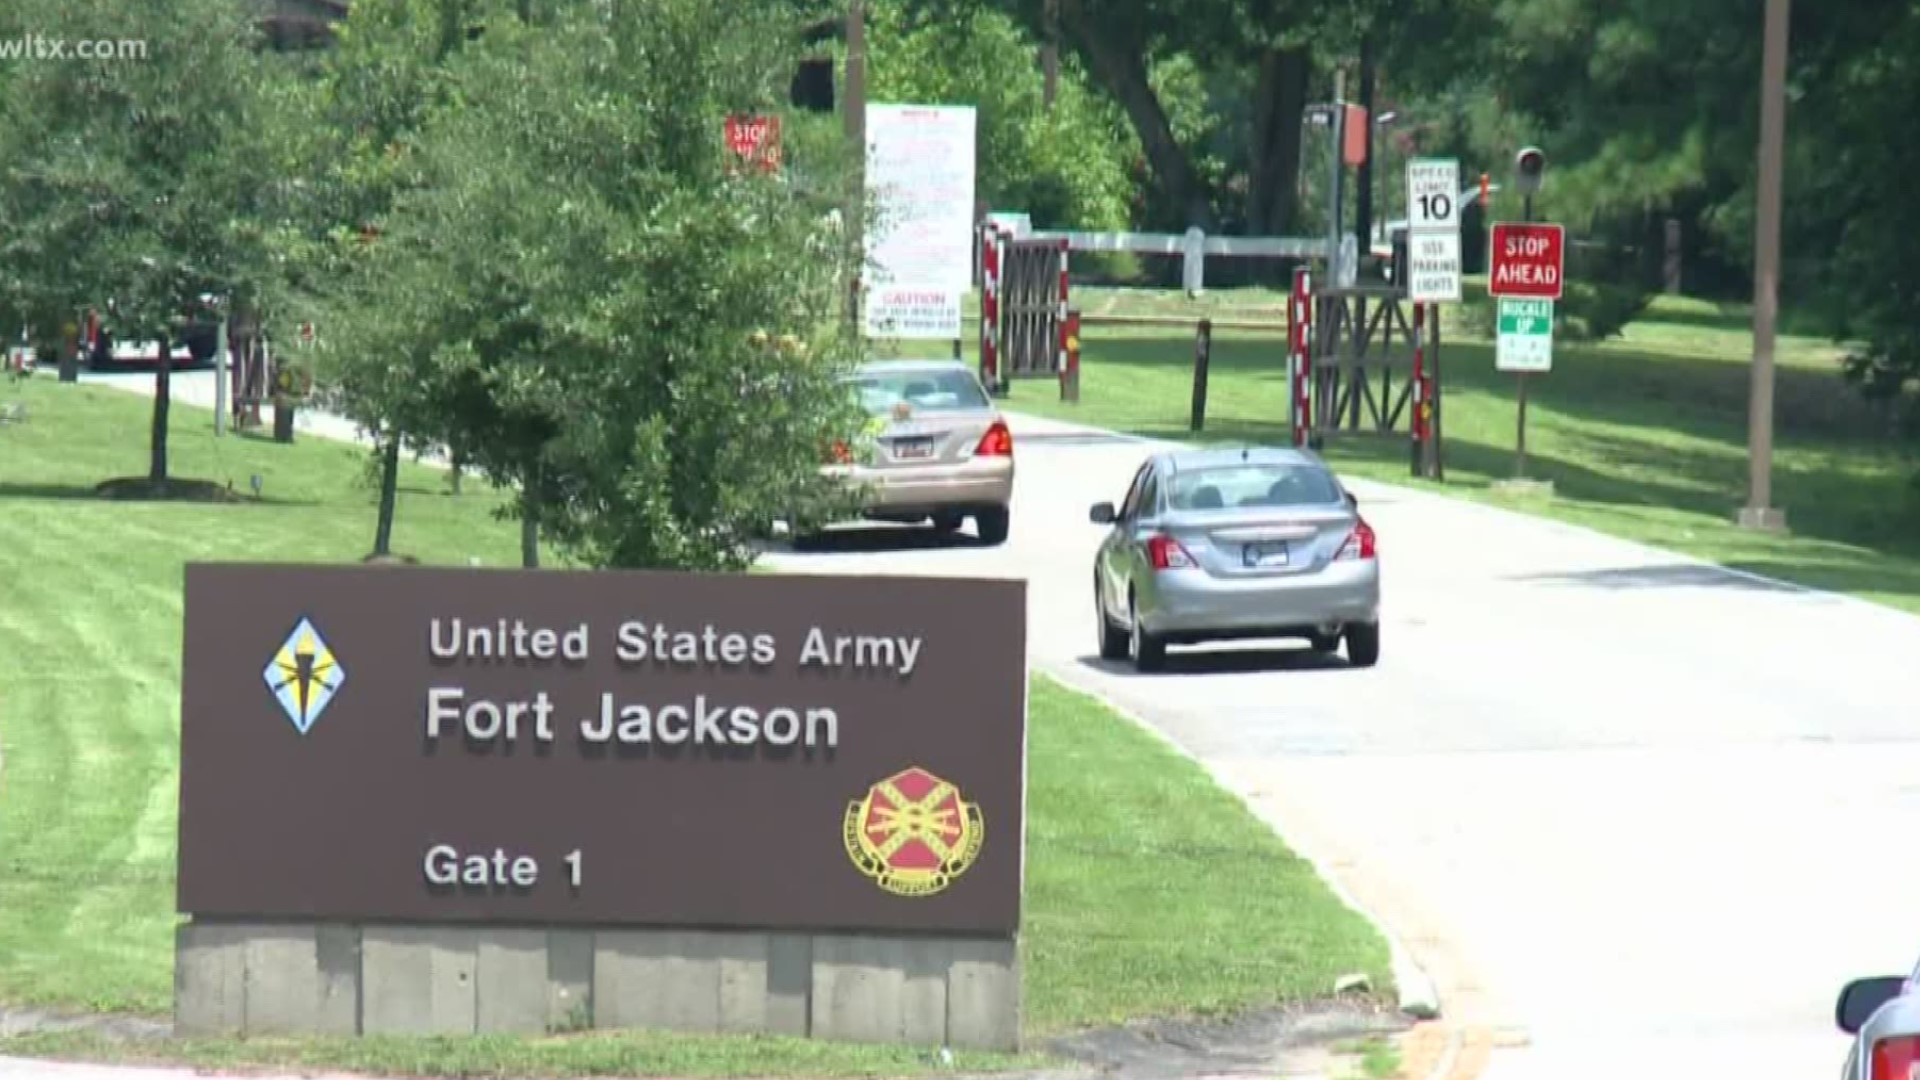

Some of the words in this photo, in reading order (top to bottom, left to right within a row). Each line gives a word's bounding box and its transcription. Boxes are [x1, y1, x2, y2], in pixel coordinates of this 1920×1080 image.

[1412, 167, 1454, 178] SPEED
[1415, 181, 1449, 191] LIMIT
[1418, 193, 1451, 220] 10
[1505, 236, 1549, 256] STOP
[1413, 258, 1457, 272] PARKING
[1496, 264, 1557, 285] AHEAD
[1416, 277, 1453, 291] LIGHTS
[882, 292, 946, 305] CAUTION
[1517, 317, 1536, 334] UP
[430, 618, 589, 660] United
[616, 621, 777, 665] States
[799, 627, 922, 674] Army
[427, 688, 554, 740] Fort
[580, 692, 839, 746] Jackson
[424, 844, 539, 885] Gate
[563, 849, 582, 886] 1
